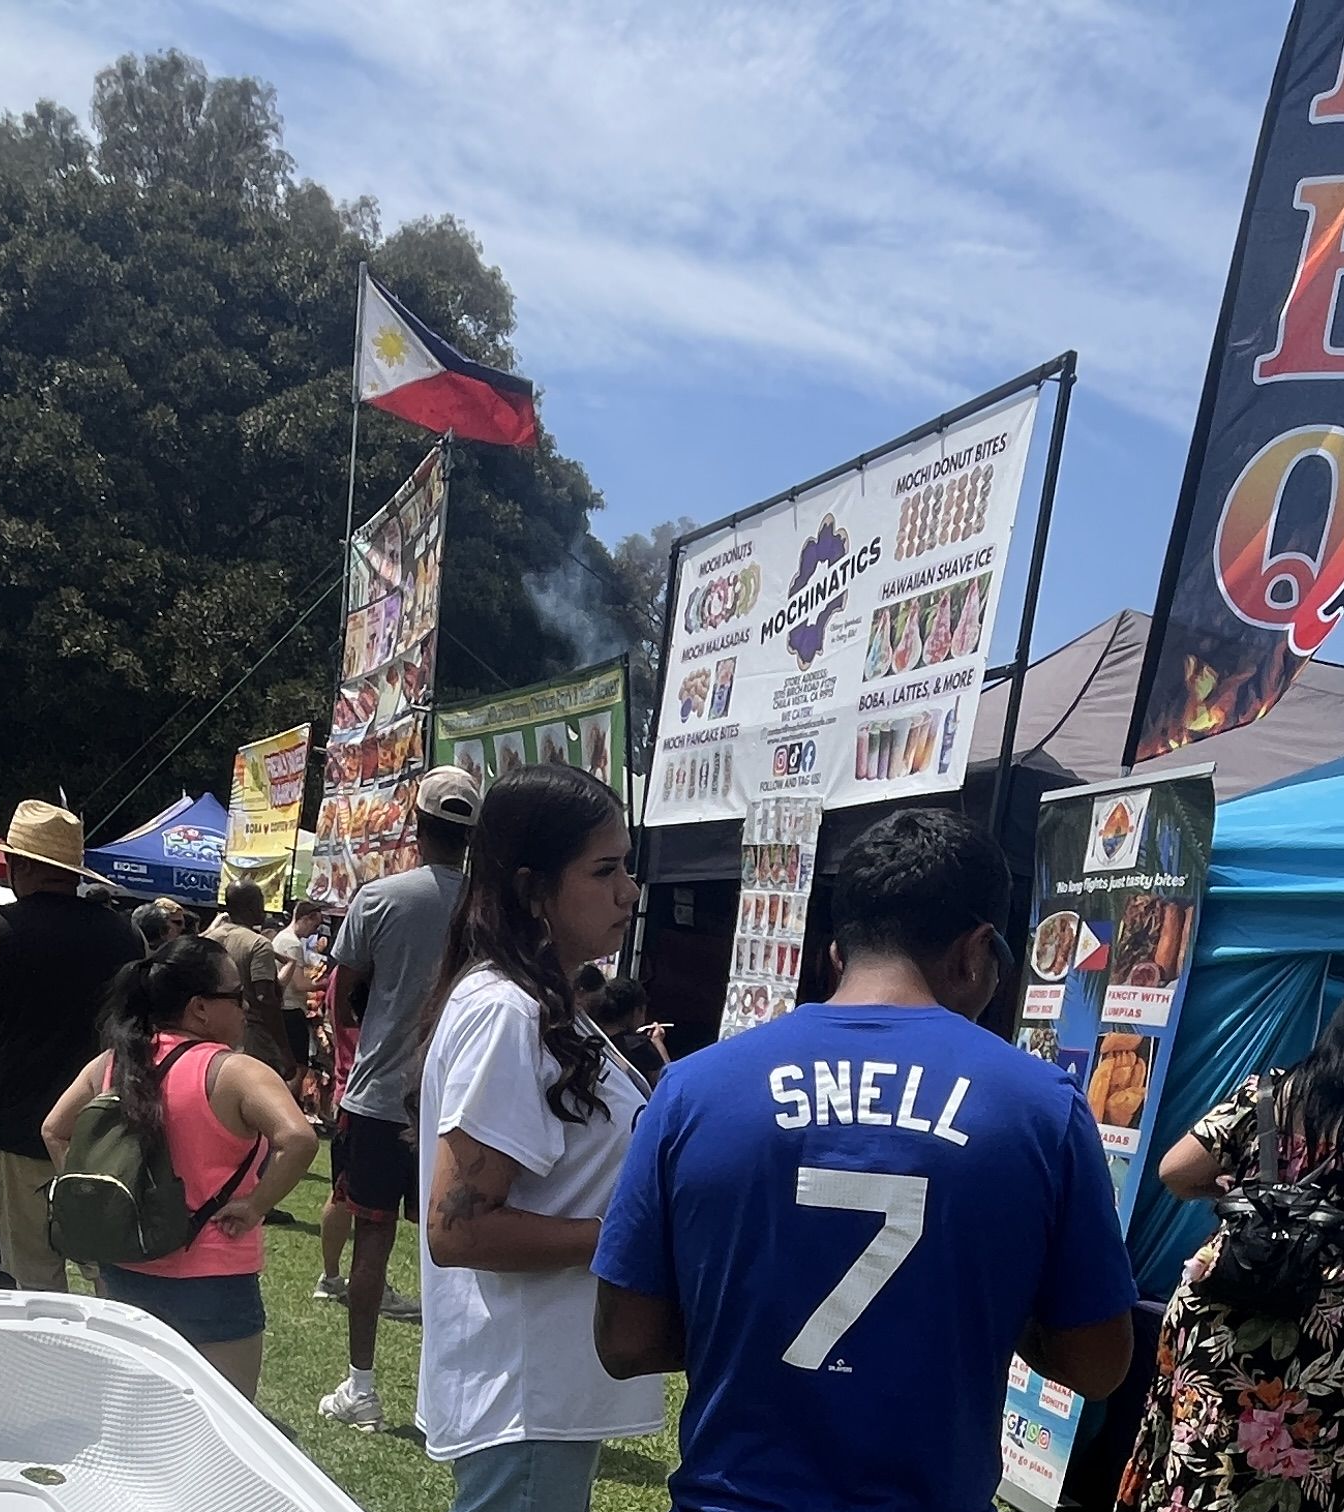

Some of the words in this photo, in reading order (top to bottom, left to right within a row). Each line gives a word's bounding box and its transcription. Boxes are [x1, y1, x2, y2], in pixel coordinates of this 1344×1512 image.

[896, 467, 931, 496] MOCHI
[933, 447, 974, 479] DONUT
[975, 433, 1008, 462] BITES
[722, 541, 753, 569] DONUTS
[882, 568, 937, 600] HAWAIIAN
[937, 556, 974, 583] SHAVE
[974, 546, 994, 569] ICE
[760, 536, 882, 645] MOCHINATICS
[942, 668, 974, 692] MORE
[663, 735, 685, 752] MOCHI
[686, 726, 719, 746] PANCAKE
[720, 722, 740, 738] BITES
[1108, 874, 1126, 892] just
[1126, 873, 1154, 890] tasty
[1105, 1007, 1142, 1018] LUMPIAS
[1140, 991, 1171, 1004] WITH
[768, 1059, 971, 1147] SNELL
[781, 1166, 929, 1371] 7
